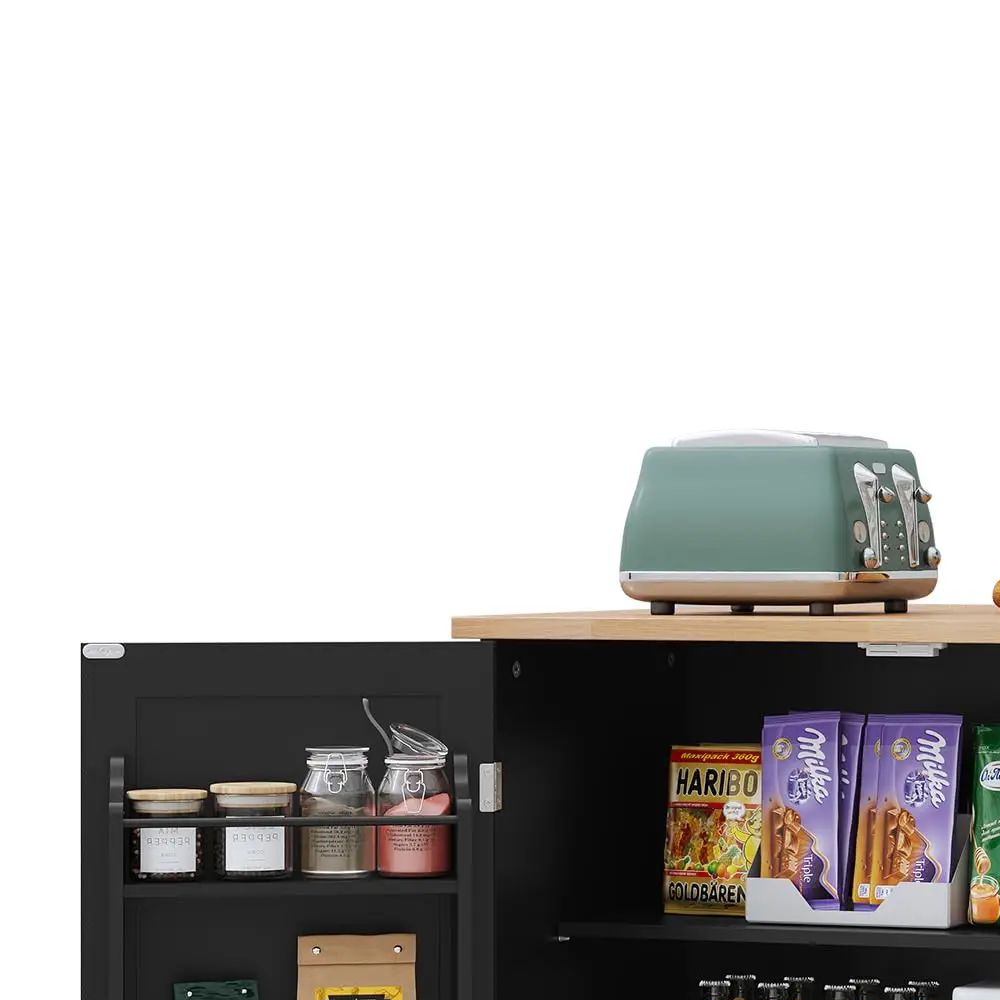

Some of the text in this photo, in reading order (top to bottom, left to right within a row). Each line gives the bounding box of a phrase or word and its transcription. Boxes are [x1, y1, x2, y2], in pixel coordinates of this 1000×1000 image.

[681, 752, 760, 763] Maxipack 360g
[797, 727, 833, 805] Milka
[917, 729, 951, 809] Milka
[676, 768, 759, 797] HARIBO
[802, 854, 814, 884] Triple
[913, 858, 925, 883] Tripl
[669, 881, 746, 903] GOLDBÄREN
